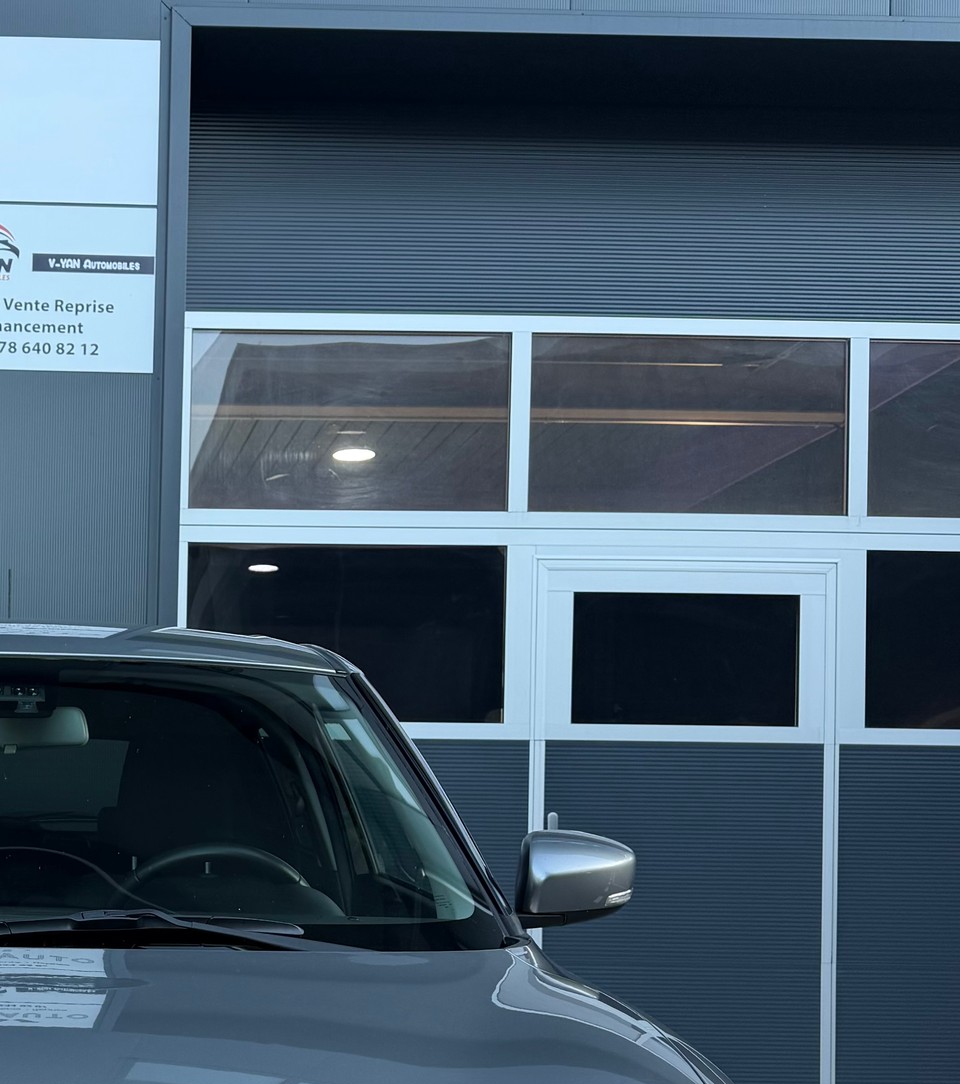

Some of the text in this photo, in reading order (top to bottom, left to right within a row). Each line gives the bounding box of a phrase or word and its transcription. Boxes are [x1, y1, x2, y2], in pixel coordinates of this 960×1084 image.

[48, 258, 80, 269] V-YAN
[4, 298, 50, 311] Vente
[54, 299, 114, 315] Reprise
[22, 342, 51, 354] 640
[56, 342, 75, 355] 82
[81, 343, 99, 356] 12
